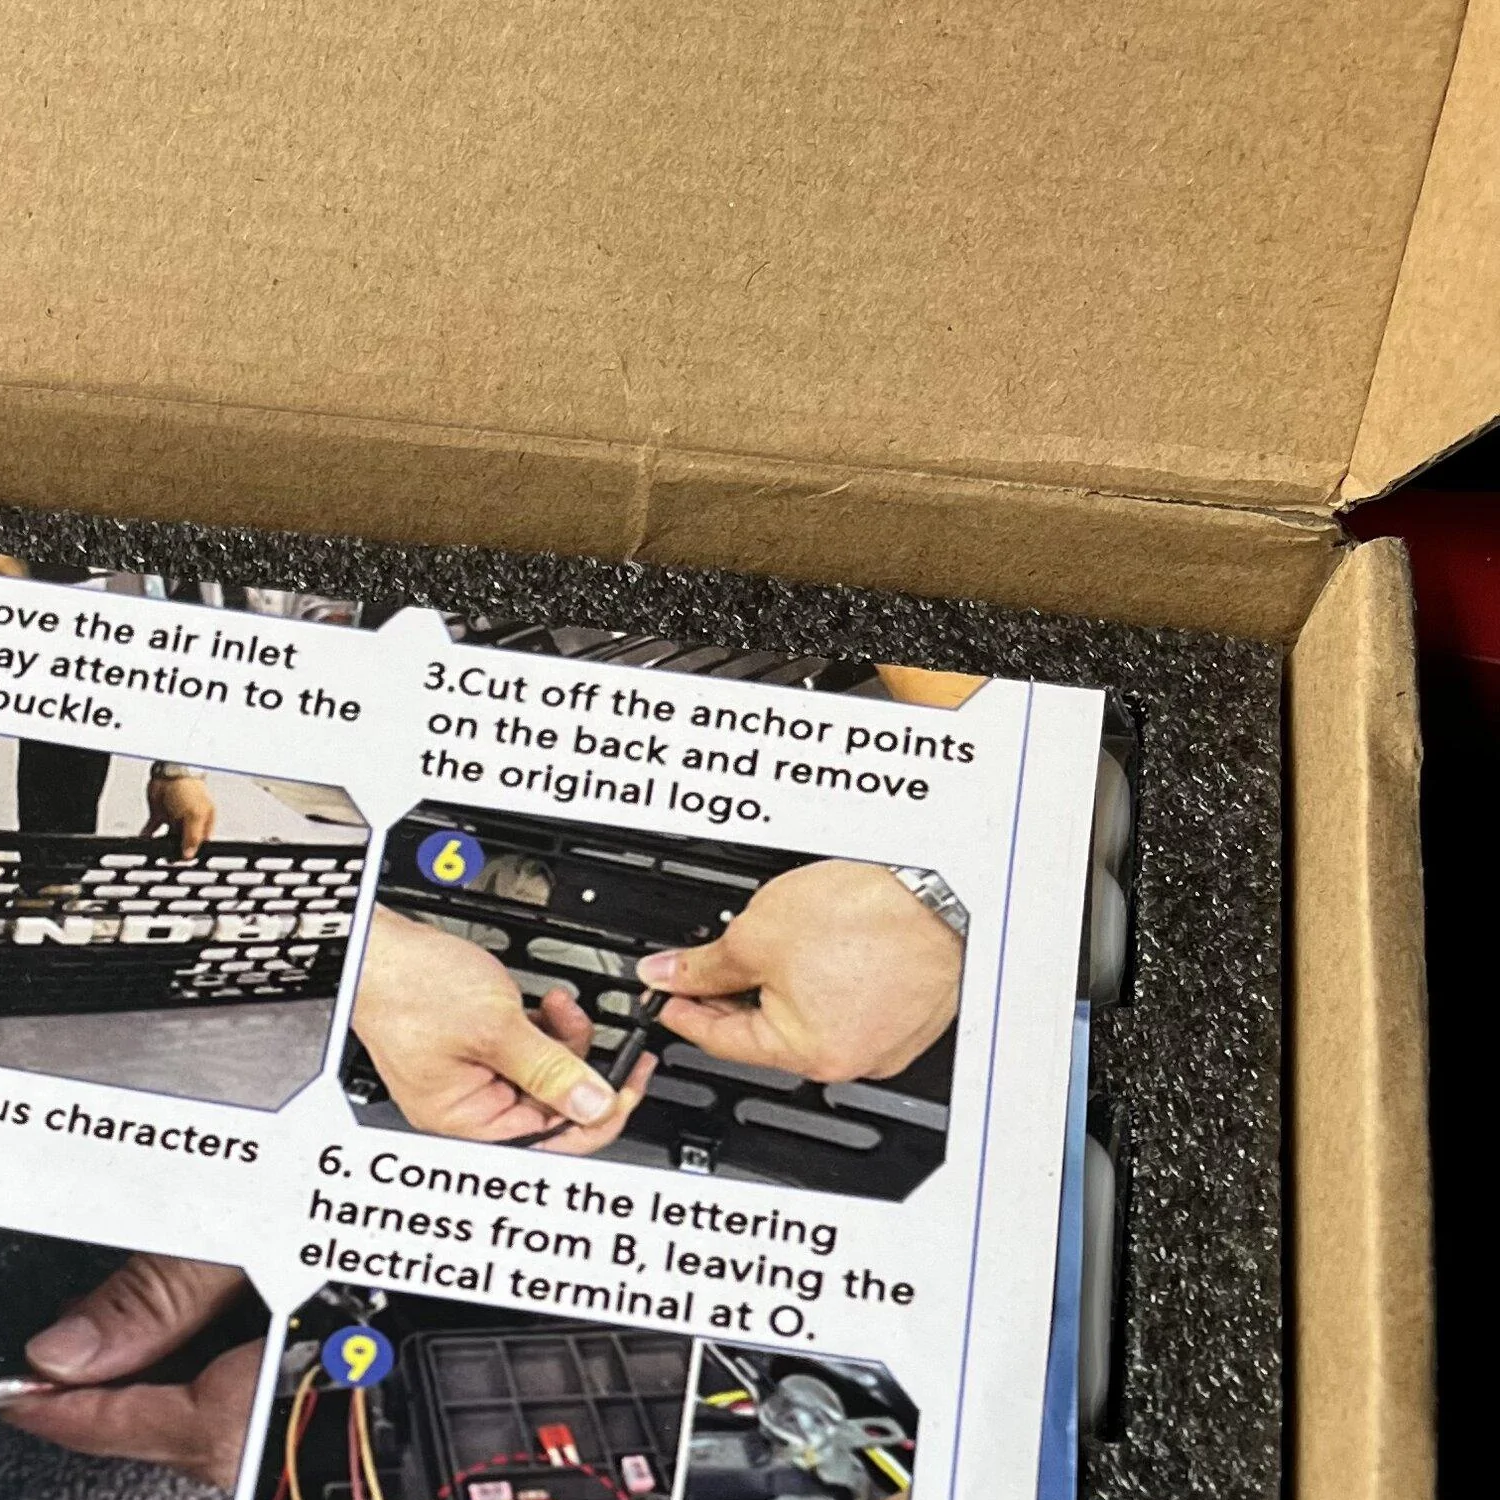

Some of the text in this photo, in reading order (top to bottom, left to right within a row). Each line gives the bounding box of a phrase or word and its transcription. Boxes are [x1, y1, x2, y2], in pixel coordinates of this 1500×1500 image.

[74, 612, 135, 645] the
[148, 624, 200, 654] air
[210, 630, 299, 670] inlet
[49, 655, 228, 704] attention
[244, 680, 284, 711] to
[298, 687, 362, 722] the
[423, 661, 975, 764] 3.Cut off the anchor points
[420, 749, 771, 825] the original logo.
[427, 713, 930, 801] on the back and remove
[434, 841, 464, 881] 6
[44, 1103, 259, 1163] characters
[318, 1144, 838, 1257] 6. Connect the lettering
[309, 1188, 916, 1306] harness from B, leaving the
[299, 1238, 815, 1341] electrical terminal at O.
[344, 1336, 376, 1379] 9
